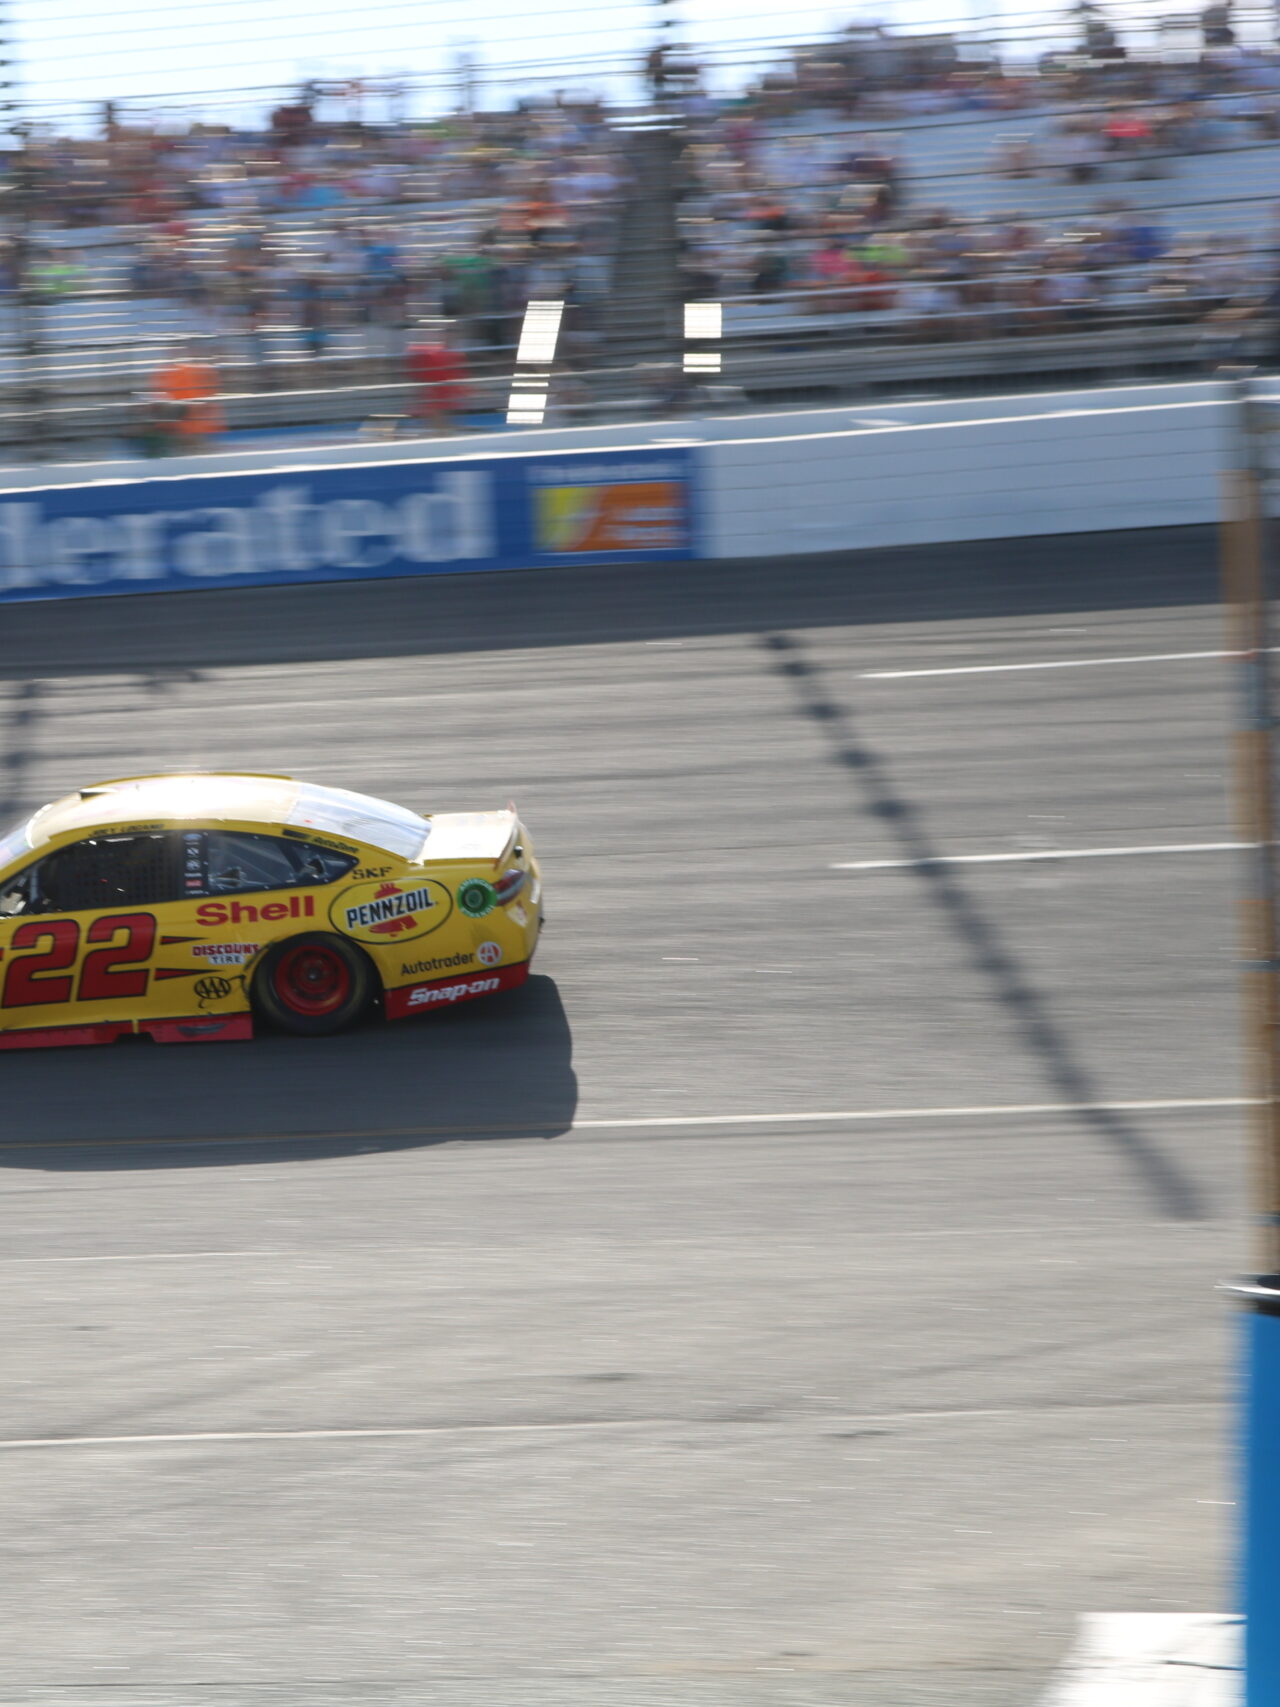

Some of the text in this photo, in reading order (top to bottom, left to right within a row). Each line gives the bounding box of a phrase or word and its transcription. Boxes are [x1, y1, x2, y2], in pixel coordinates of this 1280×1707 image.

[352, 867, 392, 880] SKF
[196, 896, 315, 926] Shell
[345, 888, 434, 930] PENNZOIL
[0, 912, 157, 1009] 22
[212, 955, 242, 963] TIRE
[401, 953, 474, 976] Autotrader
[195, 977, 231, 999] AAA
[408, 977, 500, 1006] Snap-on
